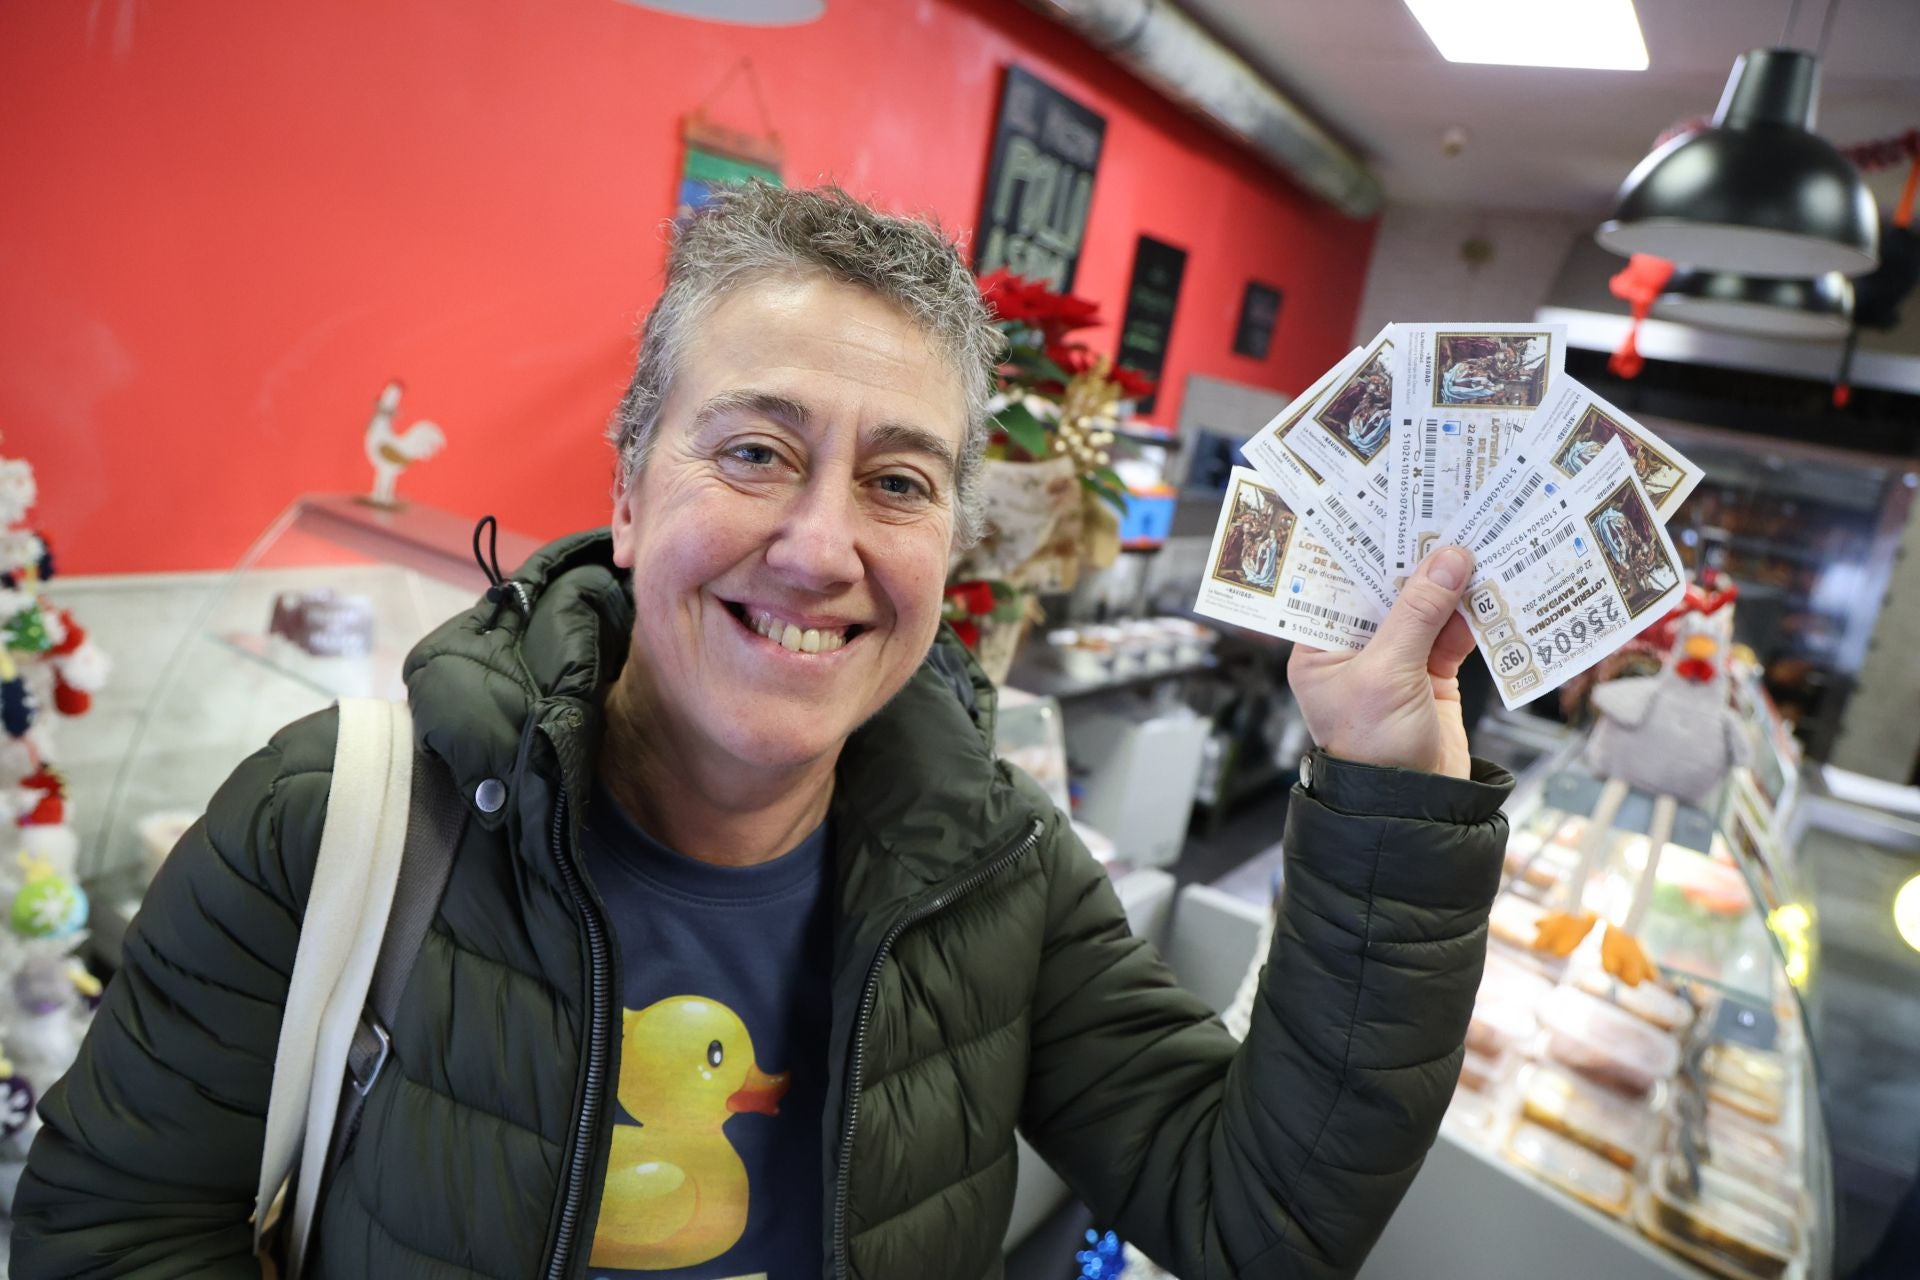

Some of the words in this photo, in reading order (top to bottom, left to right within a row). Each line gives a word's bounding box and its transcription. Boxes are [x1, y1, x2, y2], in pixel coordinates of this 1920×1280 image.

[1467, 423, 1475, 433] 22
[1466, 436, 1474, 446] de
[1477, 437, 1486, 453] DE
[1488, 417, 1500, 468] LOTERÍA
[1464, 448, 1474, 488] diciembre
[1396, 432, 1410, 556] 5102410165>0765436655
[1463, 490, 1471, 500] de
[1449, 466, 1517, 549] 5102406034>05297
[1312, 556, 1328, 567] DE
[1574, 565, 1585, 576] de
[1582, 559, 1593, 570] 22
[1296, 562, 1308, 572] 22
[1307, 565, 1318, 575] de
[1319, 568, 1356, 586] diciembre
[1574, 576, 1589, 590] DE
[1545, 571, 1577, 598] diciembre
[1570, 576, 1607, 609] LOTERÍA
[1476, 596, 1495, 615] 20
[1520, 598, 1538, 614] 2024
[1534, 585, 1576, 618] NAVIDAD
[1536, 592, 1547, 604] de
[1525, 603, 1572, 637] NACIONAL
[1533, 597, 1622, 667] 25604
